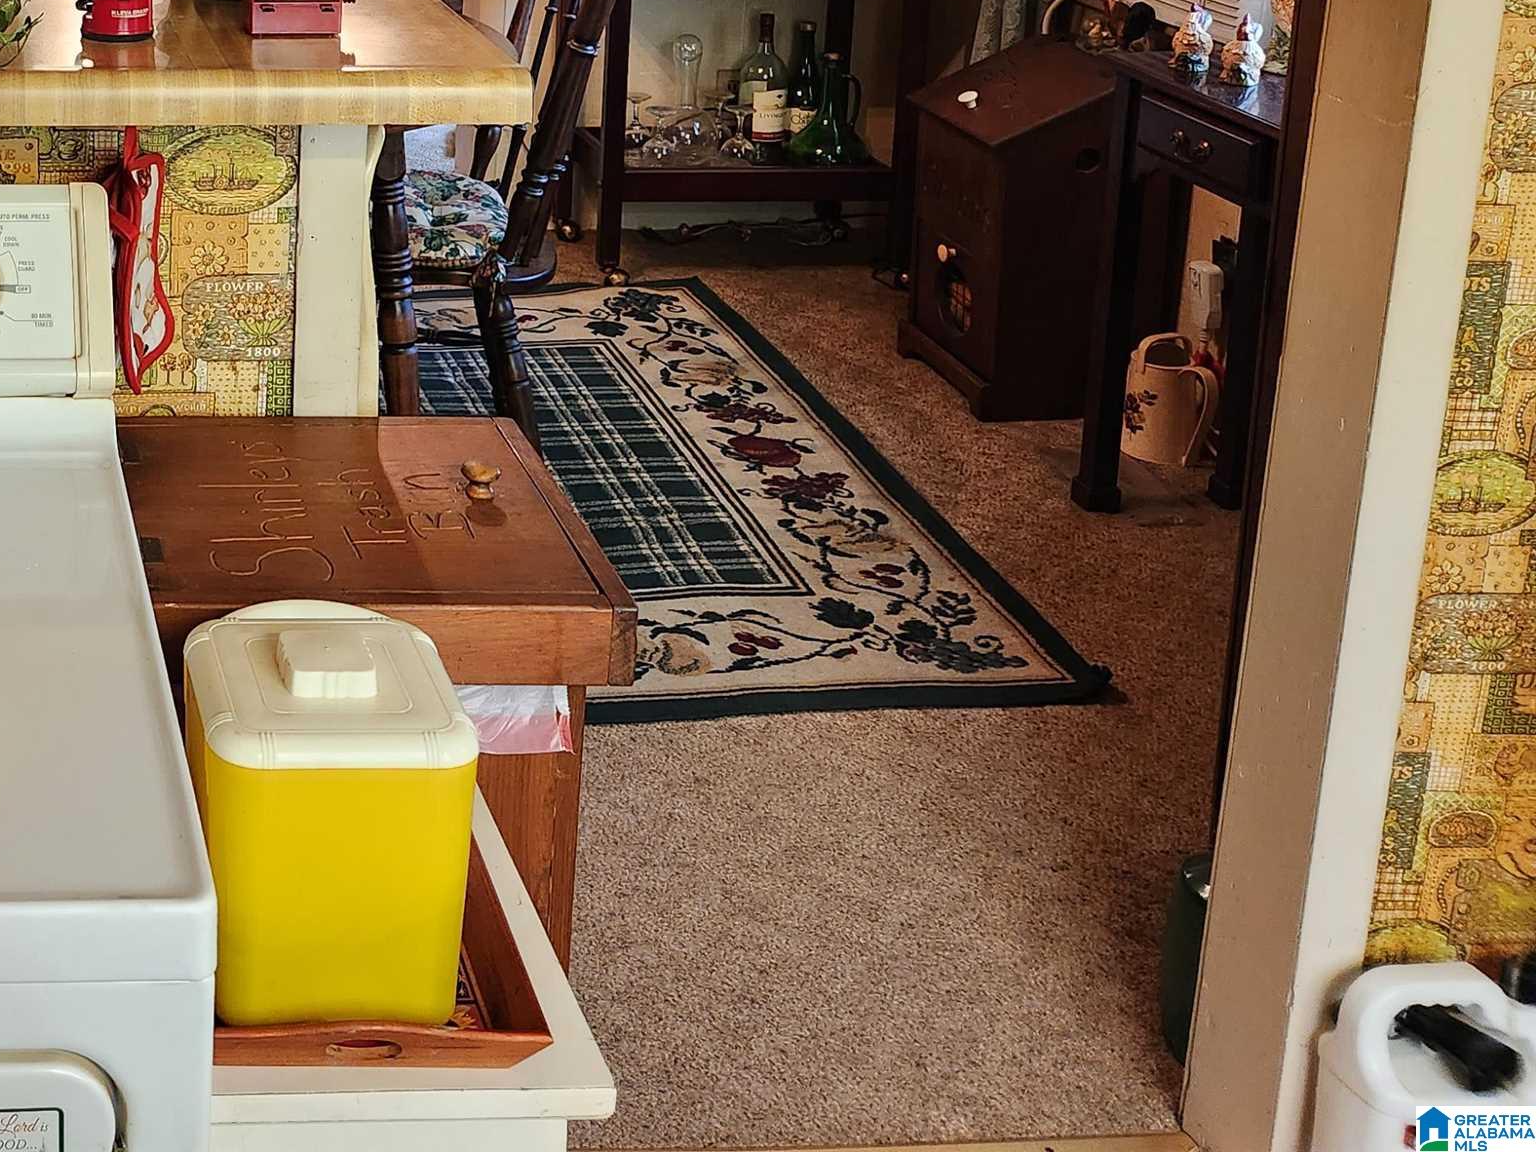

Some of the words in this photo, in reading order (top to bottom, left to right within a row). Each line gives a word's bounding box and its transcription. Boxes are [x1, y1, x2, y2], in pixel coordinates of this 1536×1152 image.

[205, 281, 265, 293] FLOWER
[245, 347, 281, 357] 1800
[402, 472, 475, 540] Bin
[317, 468, 407, 559] Trash
[1438, 599, 1498, 609] FLOWER
[40, 1121, 49, 1133] is
